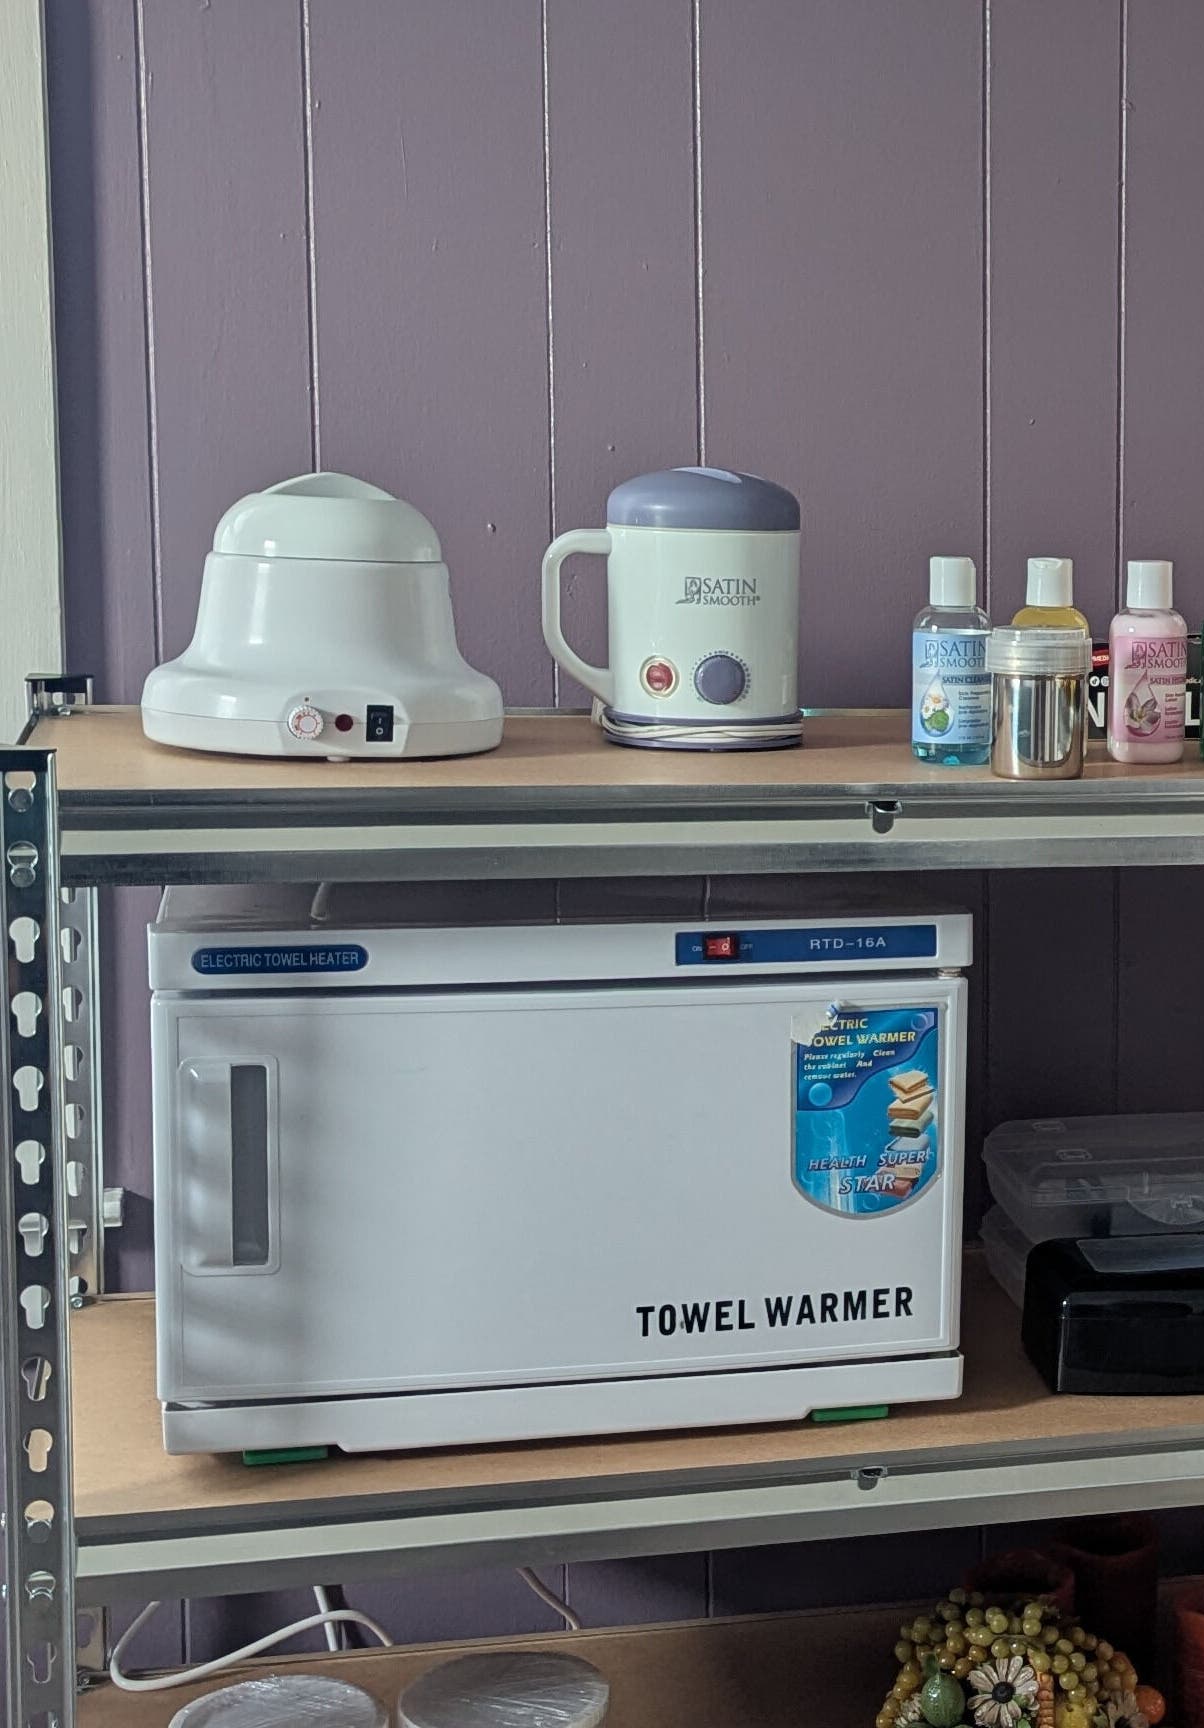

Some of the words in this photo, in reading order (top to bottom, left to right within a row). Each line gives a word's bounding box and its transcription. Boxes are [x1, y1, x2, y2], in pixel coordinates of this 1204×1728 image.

[702, 577, 757, 595] SATIN
[940, 656, 985, 669] SMOOT
[1148, 658, 1186, 669] SMOOT
[810, 936, 886, 950] RTD-16A
[201, 953, 262, 968] ELECTRIC
[265, 952, 308, 967] TOWEL
[310, 951, 359, 966] HEATER
[820, 1018, 869, 1031] ECTRIC
[813, 1035, 854, 1048] OWEL
[856, 1031, 916, 1045] WARMER
[804, 1053, 828, 1061] Please
[873, 1049, 896, 1057] Clean
[856, 1060, 873, 1068] And
[808, 1155, 867, 1171] HEALTH
[838, 1173, 897, 1195] STAR
[636, 1299, 756, 1337] TOWEL
[764, 1286, 913, 1328] WARMER
